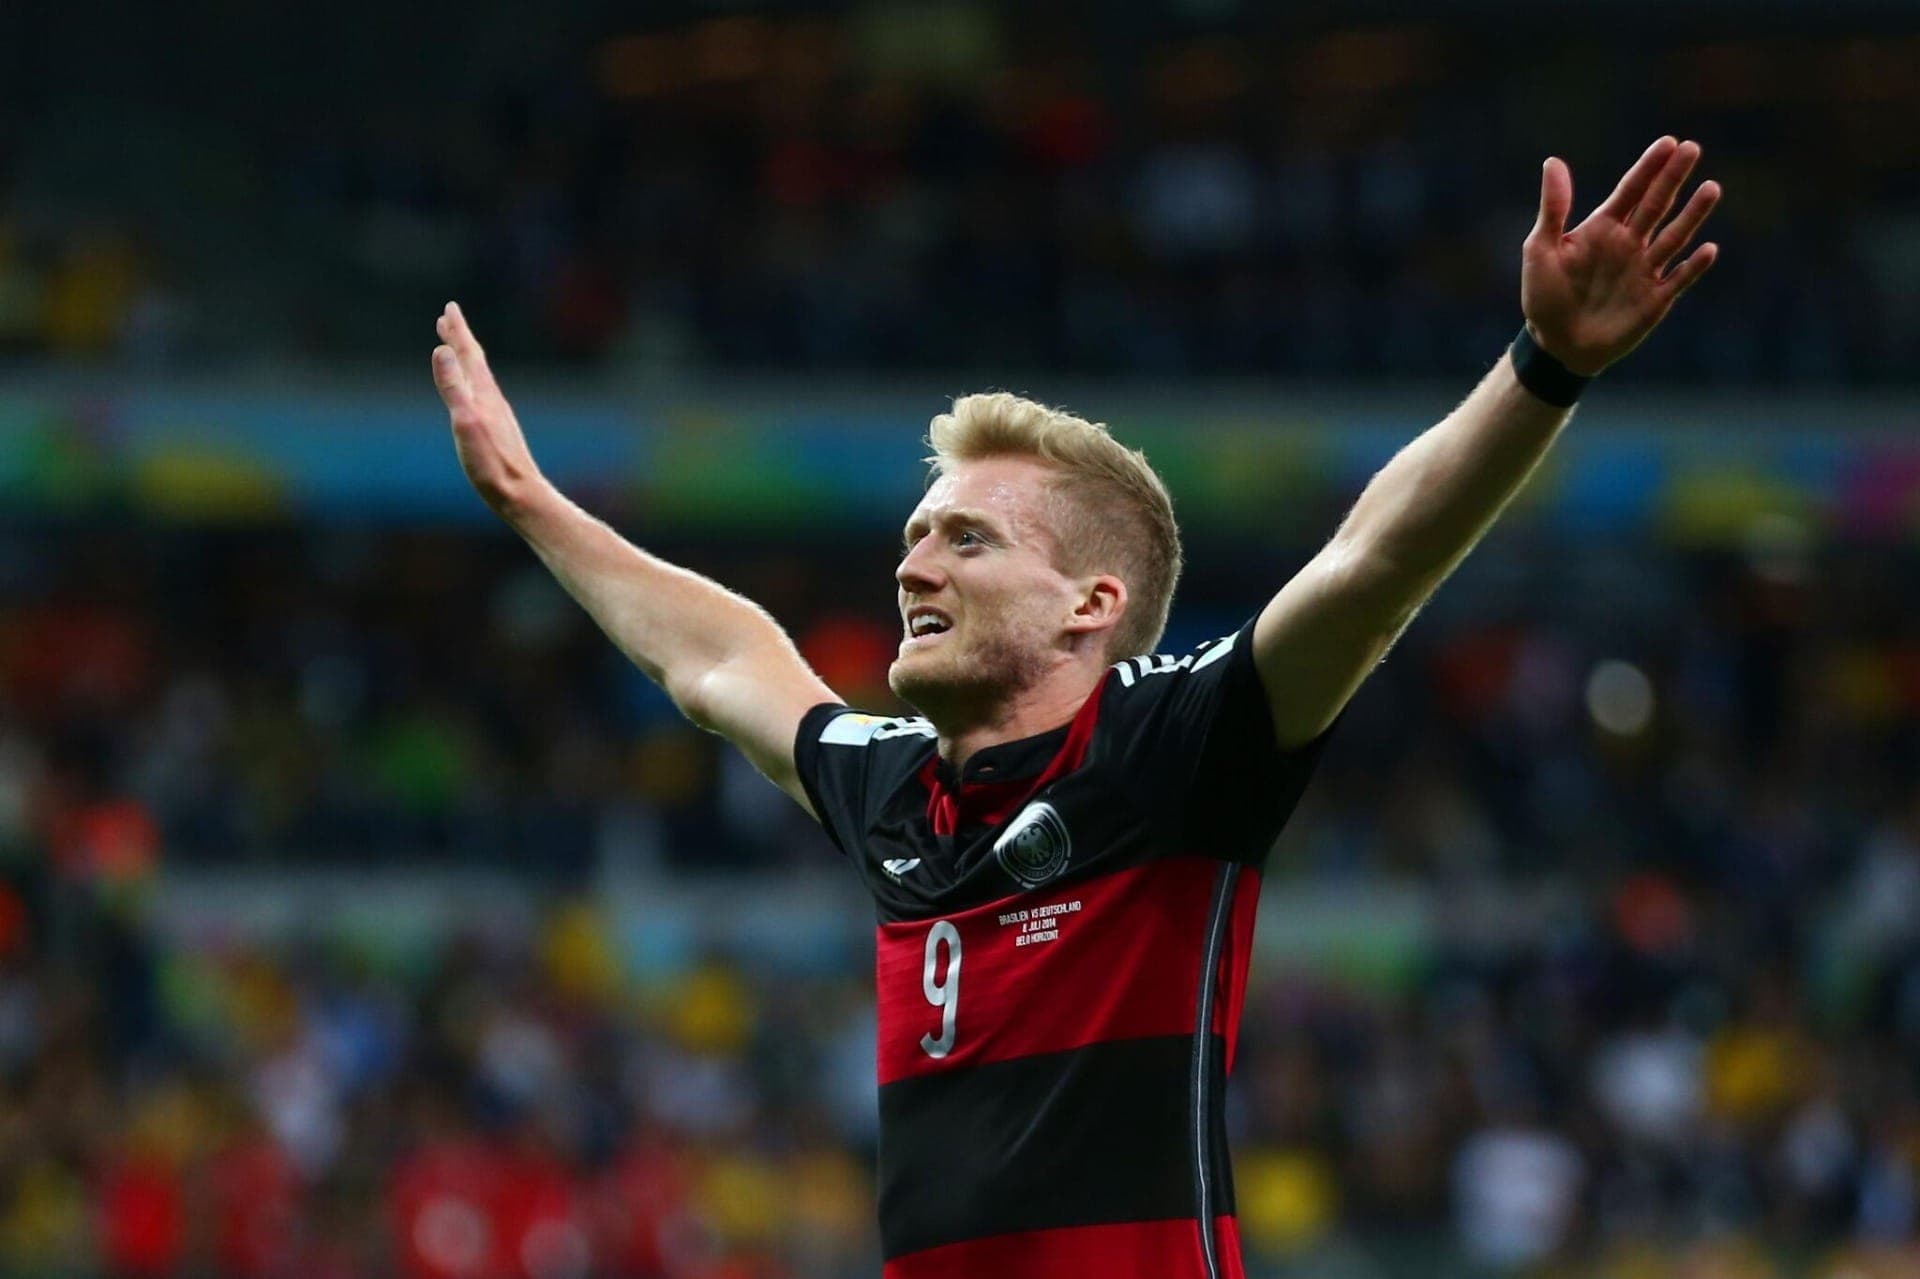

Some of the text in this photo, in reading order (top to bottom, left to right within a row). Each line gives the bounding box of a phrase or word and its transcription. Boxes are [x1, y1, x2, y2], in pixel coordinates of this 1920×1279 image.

[999, 901, 1081, 926] BRASILIEN VS DEUTSCHLAND
[1028, 920, 1041, 932] JULI
[1042, 918, 1056, 929] 2014
[920, 920, 962, 1058] 9
